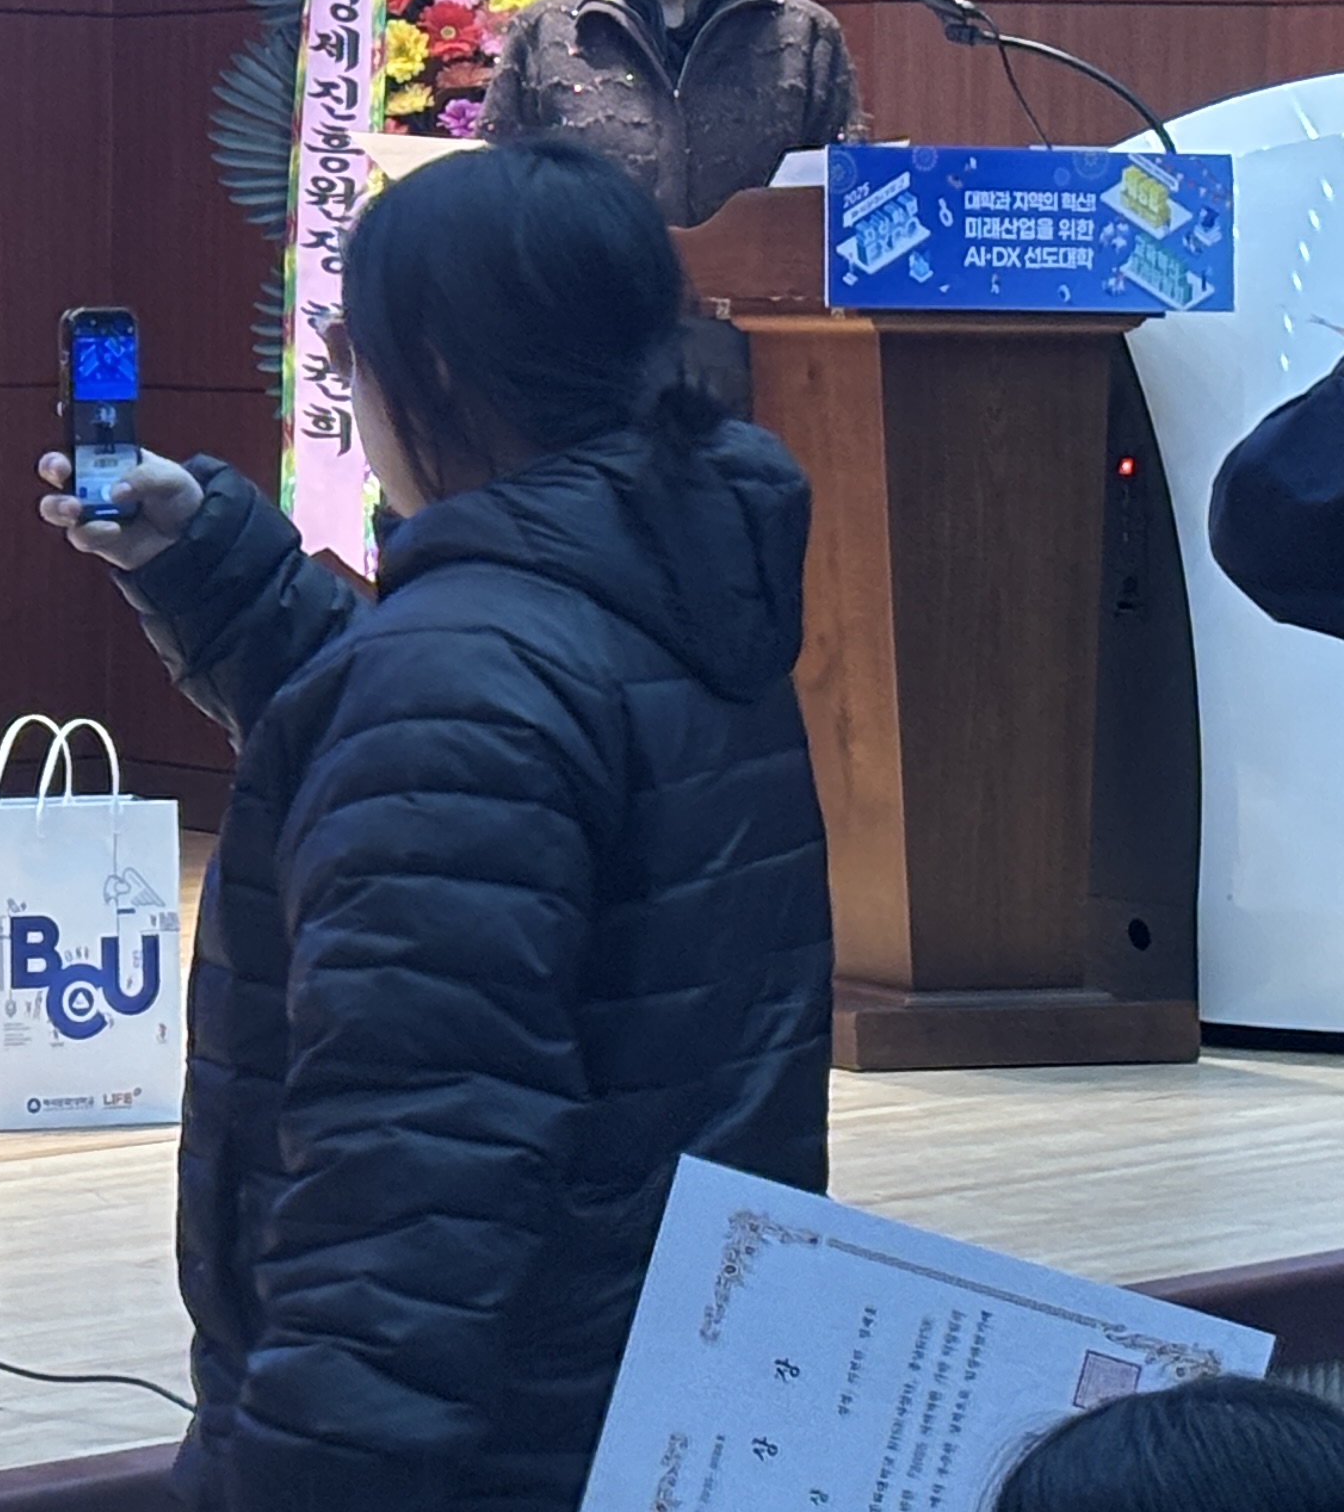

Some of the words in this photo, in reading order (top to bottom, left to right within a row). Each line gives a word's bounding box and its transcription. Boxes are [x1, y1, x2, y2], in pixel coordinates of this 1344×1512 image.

[1013, 191, 1059, 211] 지역의
[965, 217, 1054, 240] 미래산업을
[1058, 218, 1094, 241] 위한
[1024, 246, 1094, 270] 선도대학
[10, 914, 160, 1041] BCU
[752, 1437, 779, 1462] 상
[774, 1358, 800, 1383] 장
